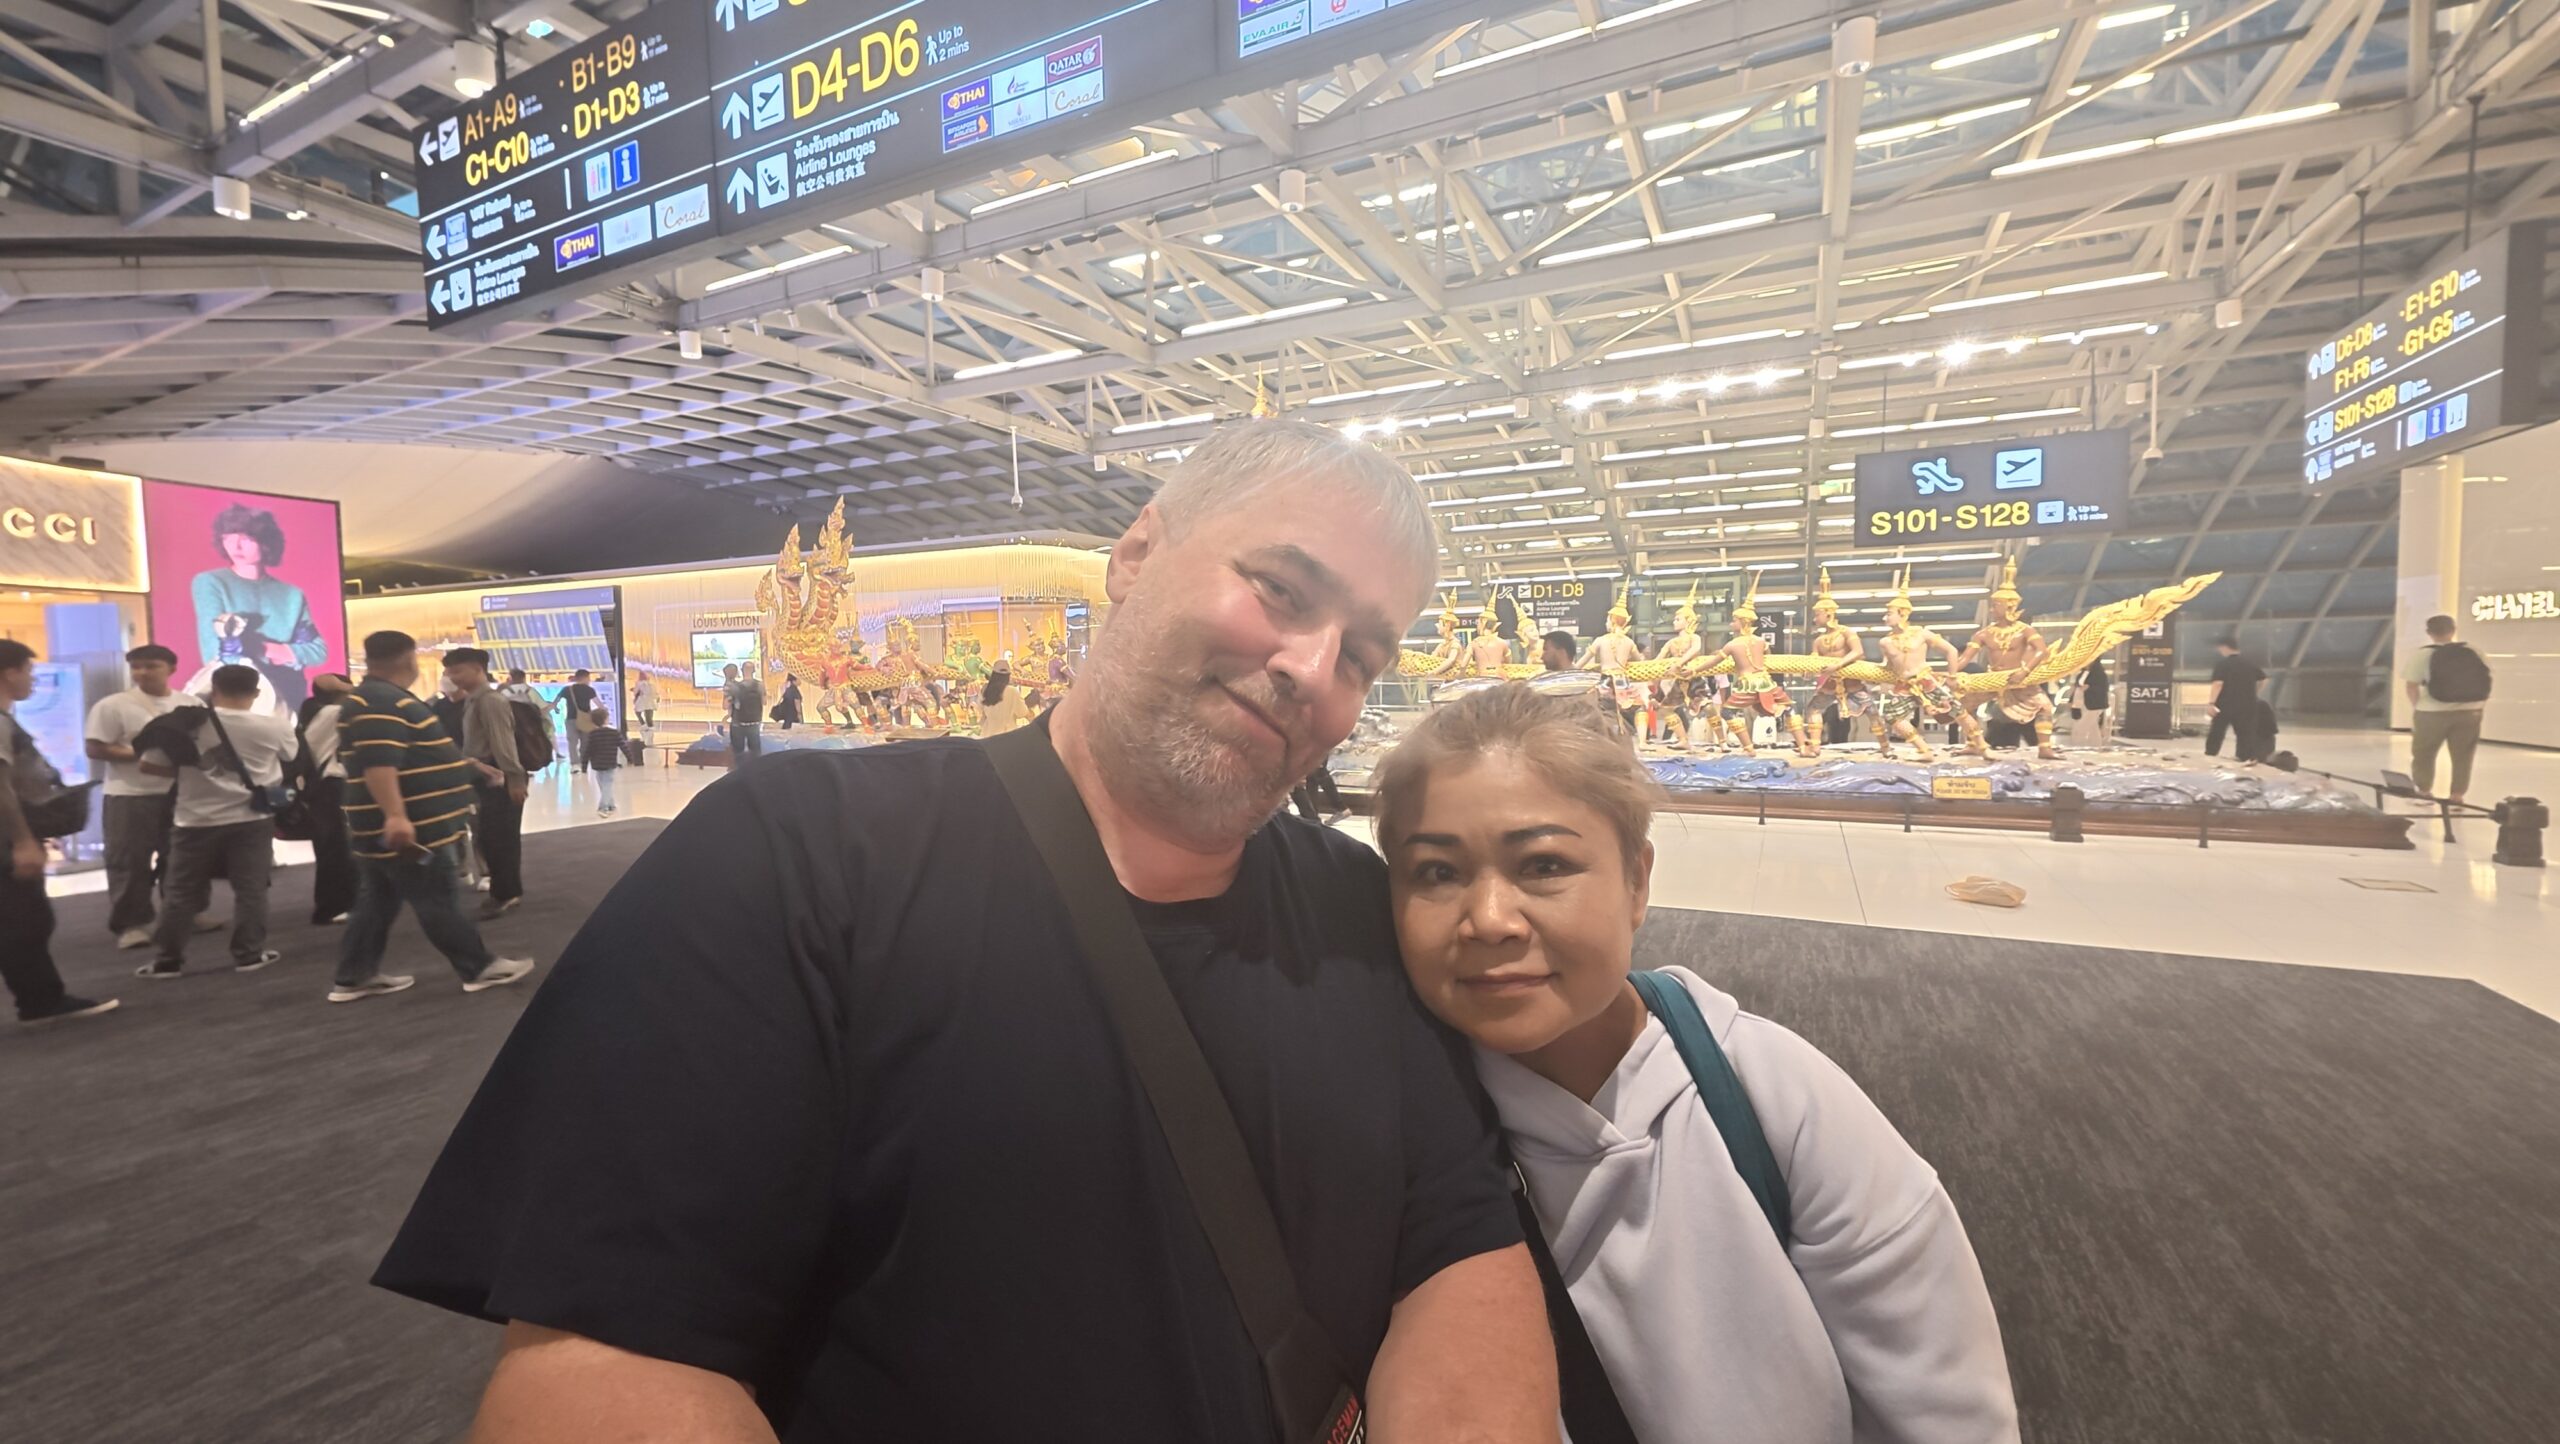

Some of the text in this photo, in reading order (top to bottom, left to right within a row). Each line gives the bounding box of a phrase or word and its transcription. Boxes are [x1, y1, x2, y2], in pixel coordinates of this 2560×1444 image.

[938, 25, 963, 44] Up to
[939, 40, 970, 62] 2 mins
[1243, 29, 1266, 42] EVA
[1269, 21, 1289, 34] AIR
[571, 33, 636, 93] B1-B9
[791, 19, 920, 119] D4-D6
[1049, 52, 1083, 74] QATAR
[574, 81, 641, 139] D1-D3
[960, 85, 986, 104] THAI
[1054, 83, 1101, 111] Coral
[464, 92, 517, 146] A1-A9
[465, 131, 530, 186] C1-C10
[795, 140, 876, 179] Airline Lounges
[571, 234, 595, 254] THAI
[2406, 270, 2459, 322] E1-E10
[2336, 322, 2373, 362] D6-D8
[2404, 309, 2454, 356] G1-G5
[2335, 355, 2370, 394] F1-F6
[2334, 384, 2397, 433] S101-S128
[693, 615, 760, 628] LOUIS VUITTON
[2130, 687, 2170, 698] SAT-1
